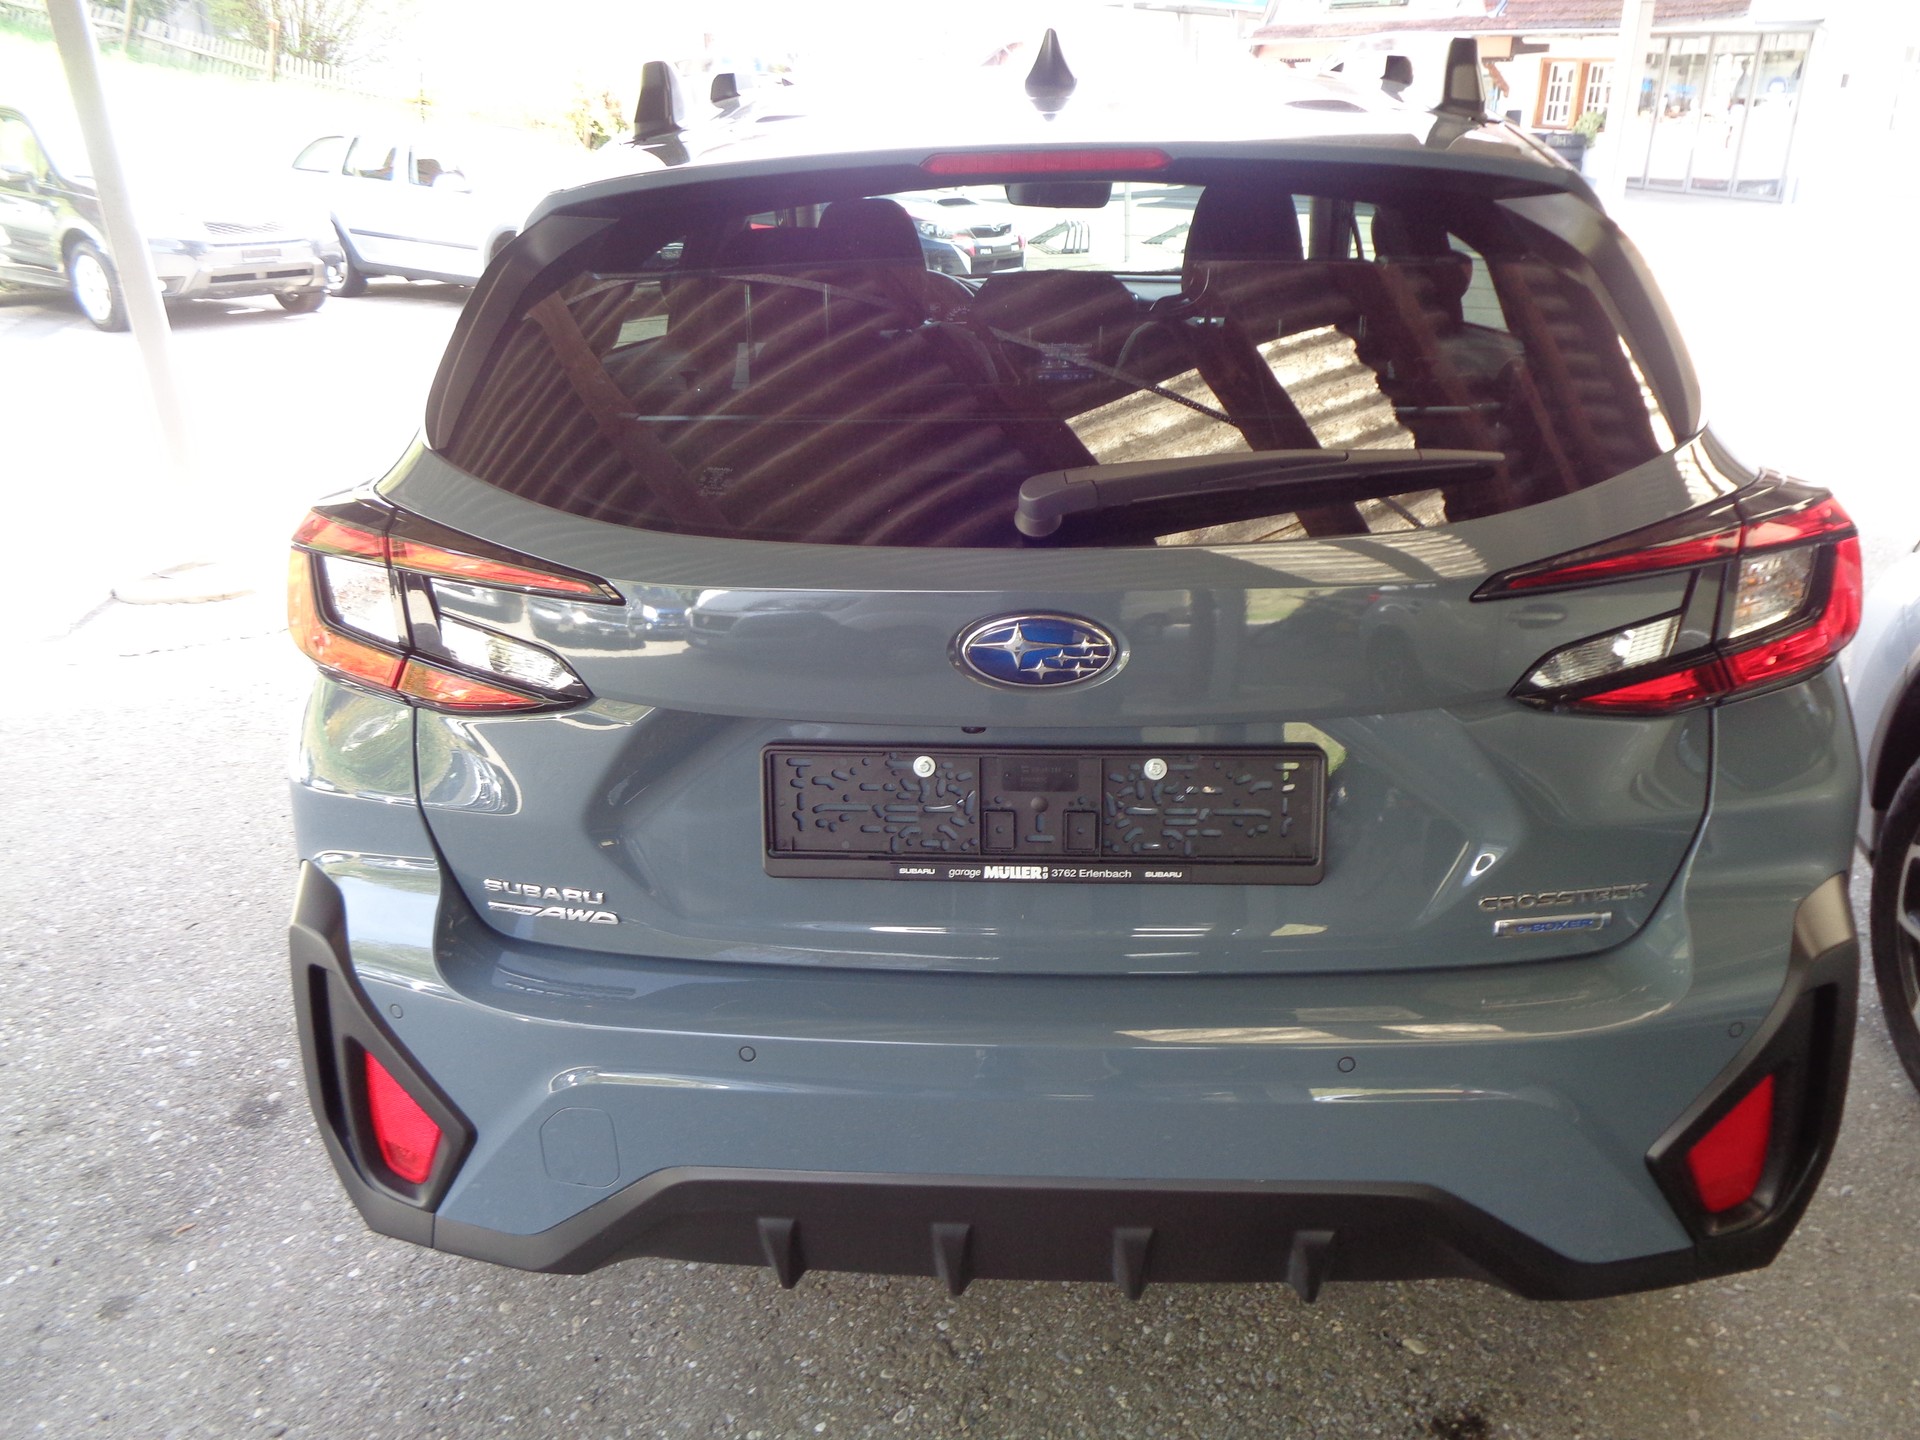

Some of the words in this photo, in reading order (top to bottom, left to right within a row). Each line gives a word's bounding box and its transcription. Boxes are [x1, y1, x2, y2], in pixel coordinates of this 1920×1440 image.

[899, 867, 936, 876] SUBARU
[948, 867, 982, 878] garage
[1051, 868, 1077, 878] 3762
[1079, 868, 1132, 879] Erlenbach
[1145, 870, 1183, 879] SUBARU
[483, 878, 606, 905] SUBARU
[1478, 883, 1649, 911] CROSSTREK
[536, 906, 620, 925] AWD
